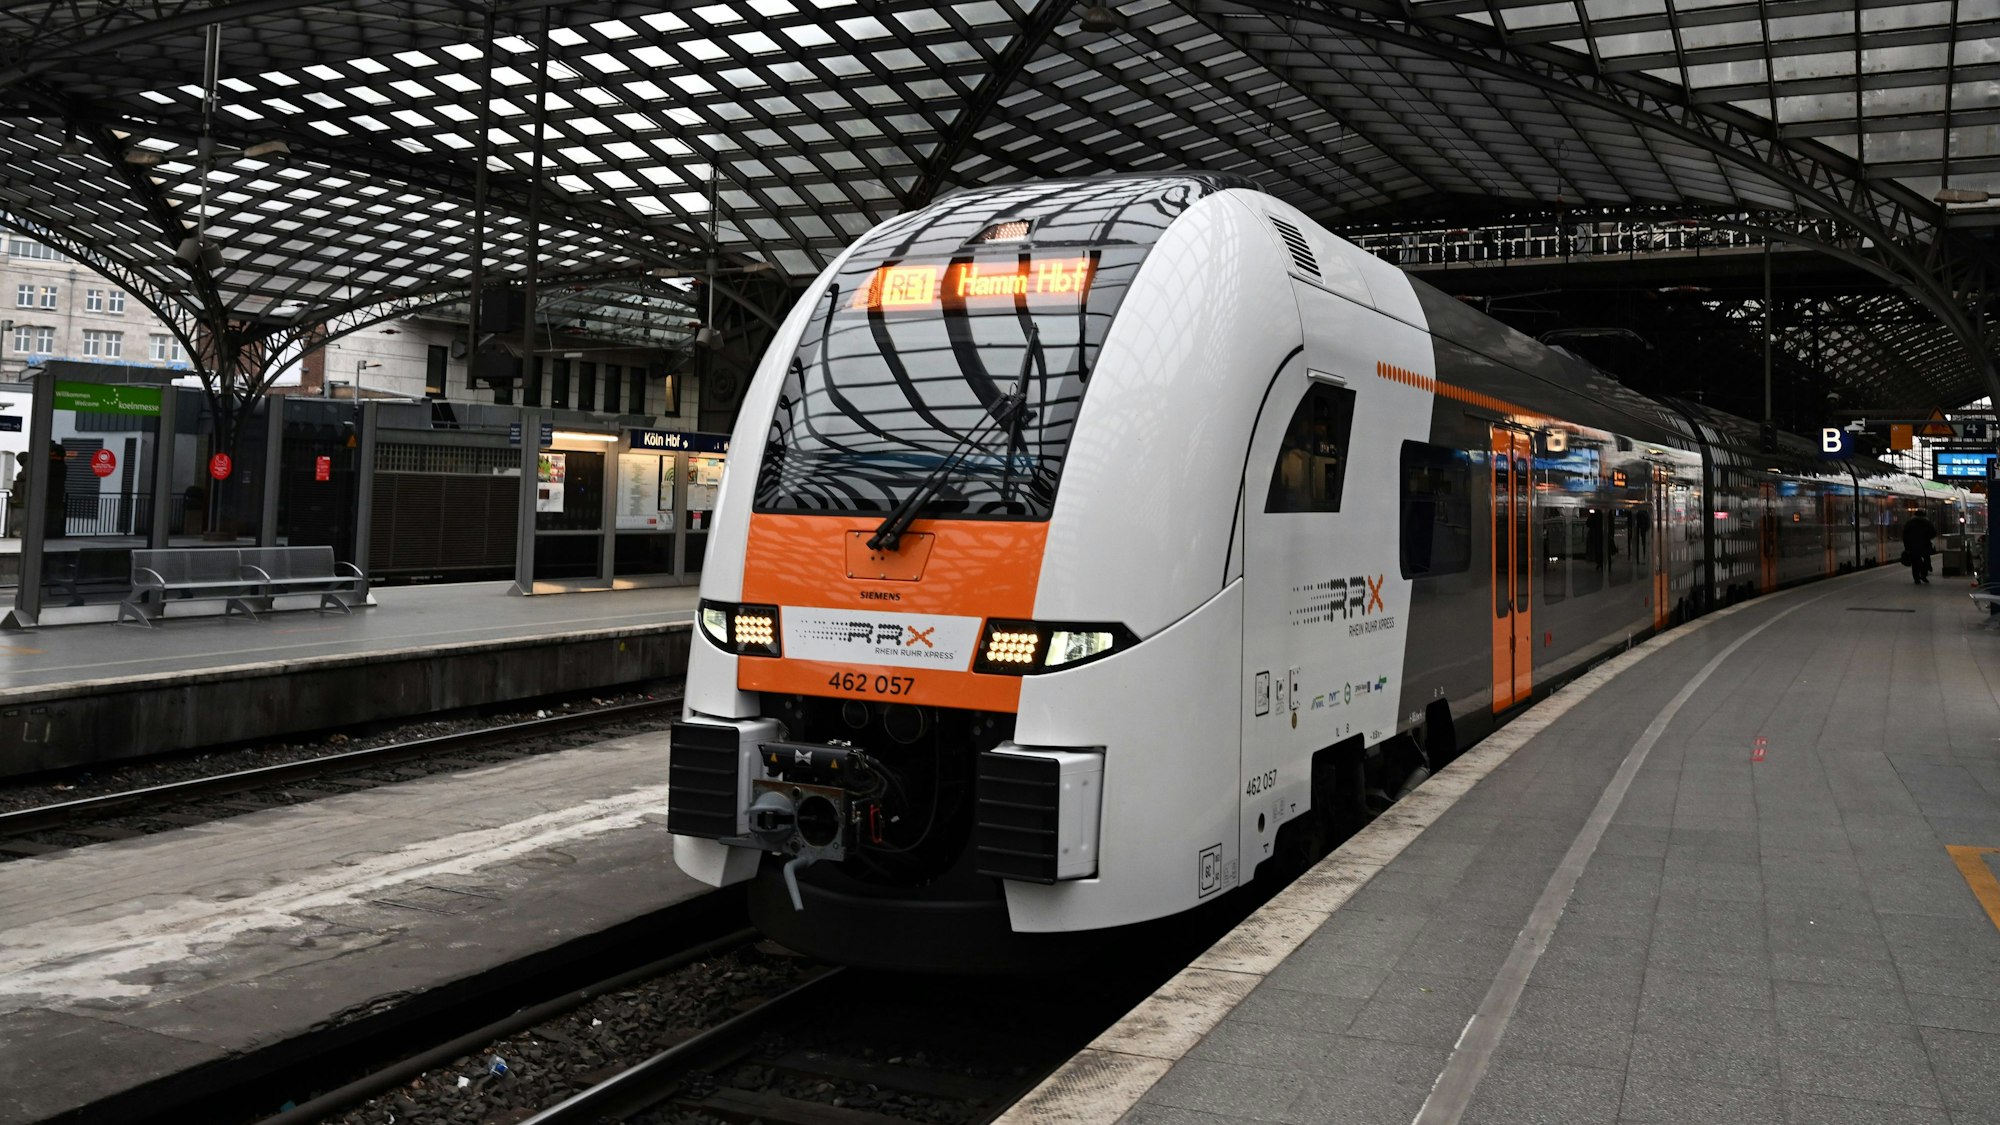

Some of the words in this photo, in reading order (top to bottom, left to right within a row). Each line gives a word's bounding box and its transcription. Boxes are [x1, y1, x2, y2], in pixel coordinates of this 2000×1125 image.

[891, 272, 929, 300] RE1
[957, 263, 1028, 297] Hamm
[1036, 259, 1088, 293] Hbf
[118, 401, 160, 411] koelnmesse
[644, 432, 663, 446] Köln
[665, 433, 680, 447] Hbf
[1822, 427, 1842, 452] B
[1966, 424, 1978, 434] 4
[860, 591, 901, 601] SIEMENS
[1329, 574, 1383, 622] RRX
[846, 621, 935, 648] RRX
[875, 647, 899, 655] RHEIN
[900, 649, 922, 657] RUHR
[924, 651, 954, 660] XPRESS
[828, 671, 867, 692] 462
[874, 675, 915, 695] 057
[1246, 776, 1261, 797] 462
[1263, 769, 1277, 790] 057
